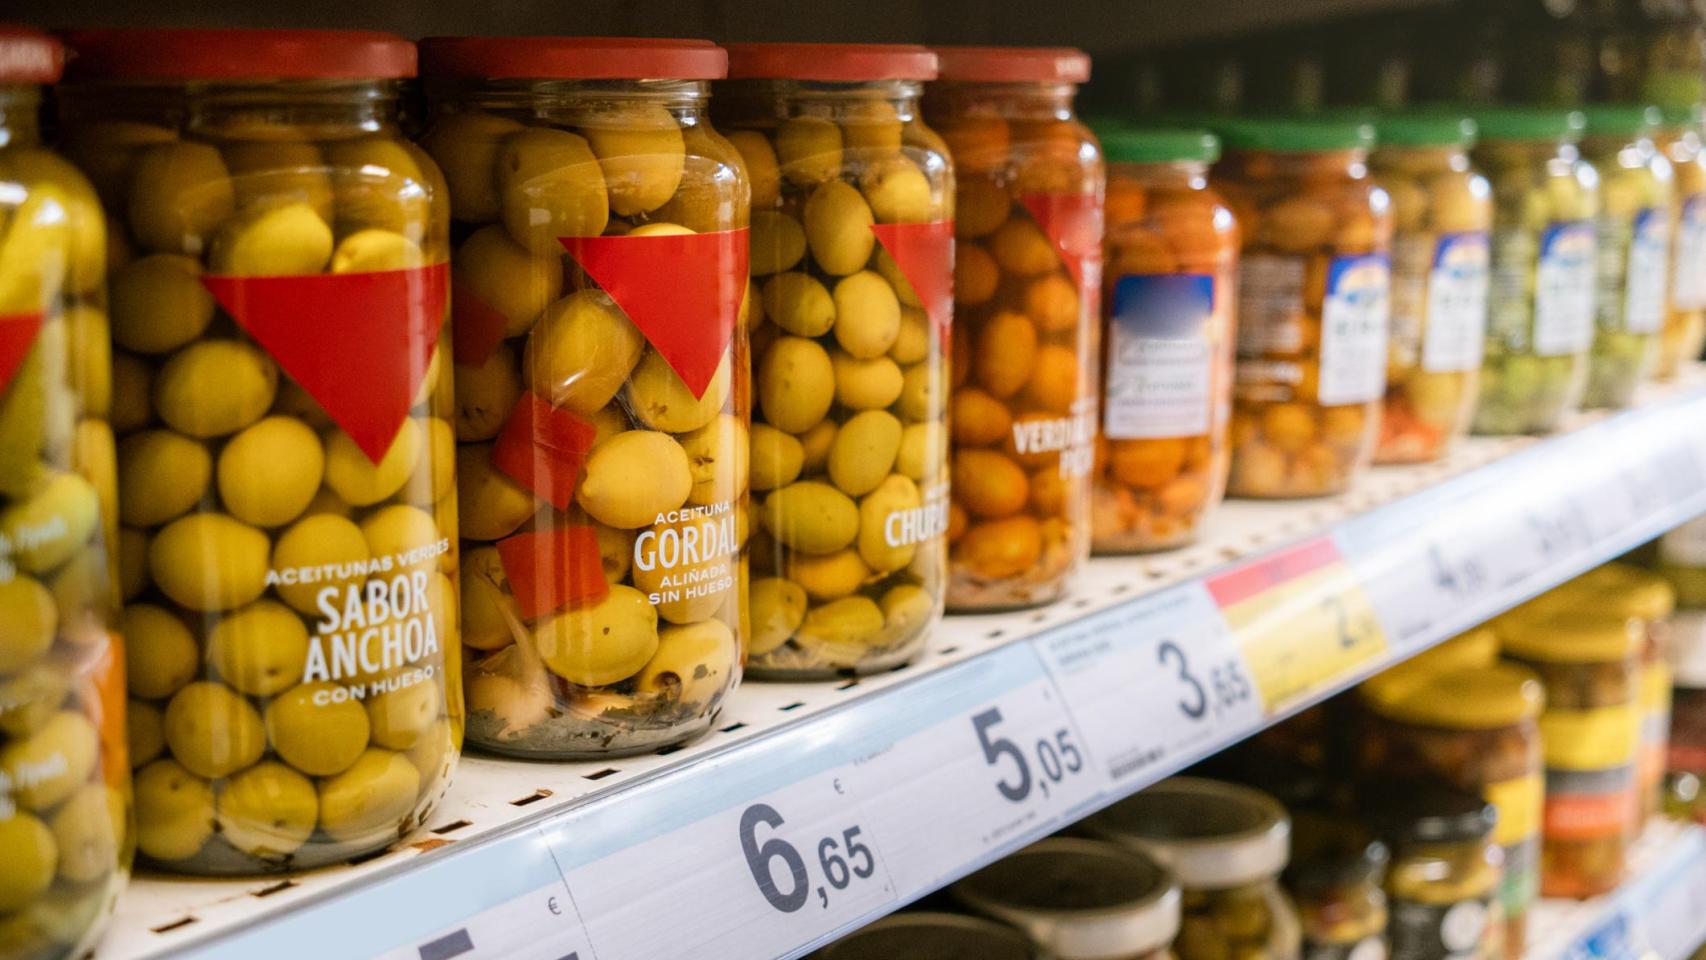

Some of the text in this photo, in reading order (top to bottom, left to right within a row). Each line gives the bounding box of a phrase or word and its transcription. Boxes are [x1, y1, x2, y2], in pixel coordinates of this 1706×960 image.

[654, 501, 730, 525] ACEITUNA
[265, 538, 449, 586] ACEITUNAS VERDES
[634, 515, 738, 571] GORDAL
[648, 576, 733, 605] SIN HUESO
[660, 563, 727, 588] ALIÑADA
[316, 570, 429, 634] SABOR
[303, 613, 438, 683] ANCHOA
[312, 665, 433, 706] CON HUESO
[971, 706, 1083, 803] 5,05
[739, 803, 875, 914] 6,65
[548, 896, 562, 916] €
